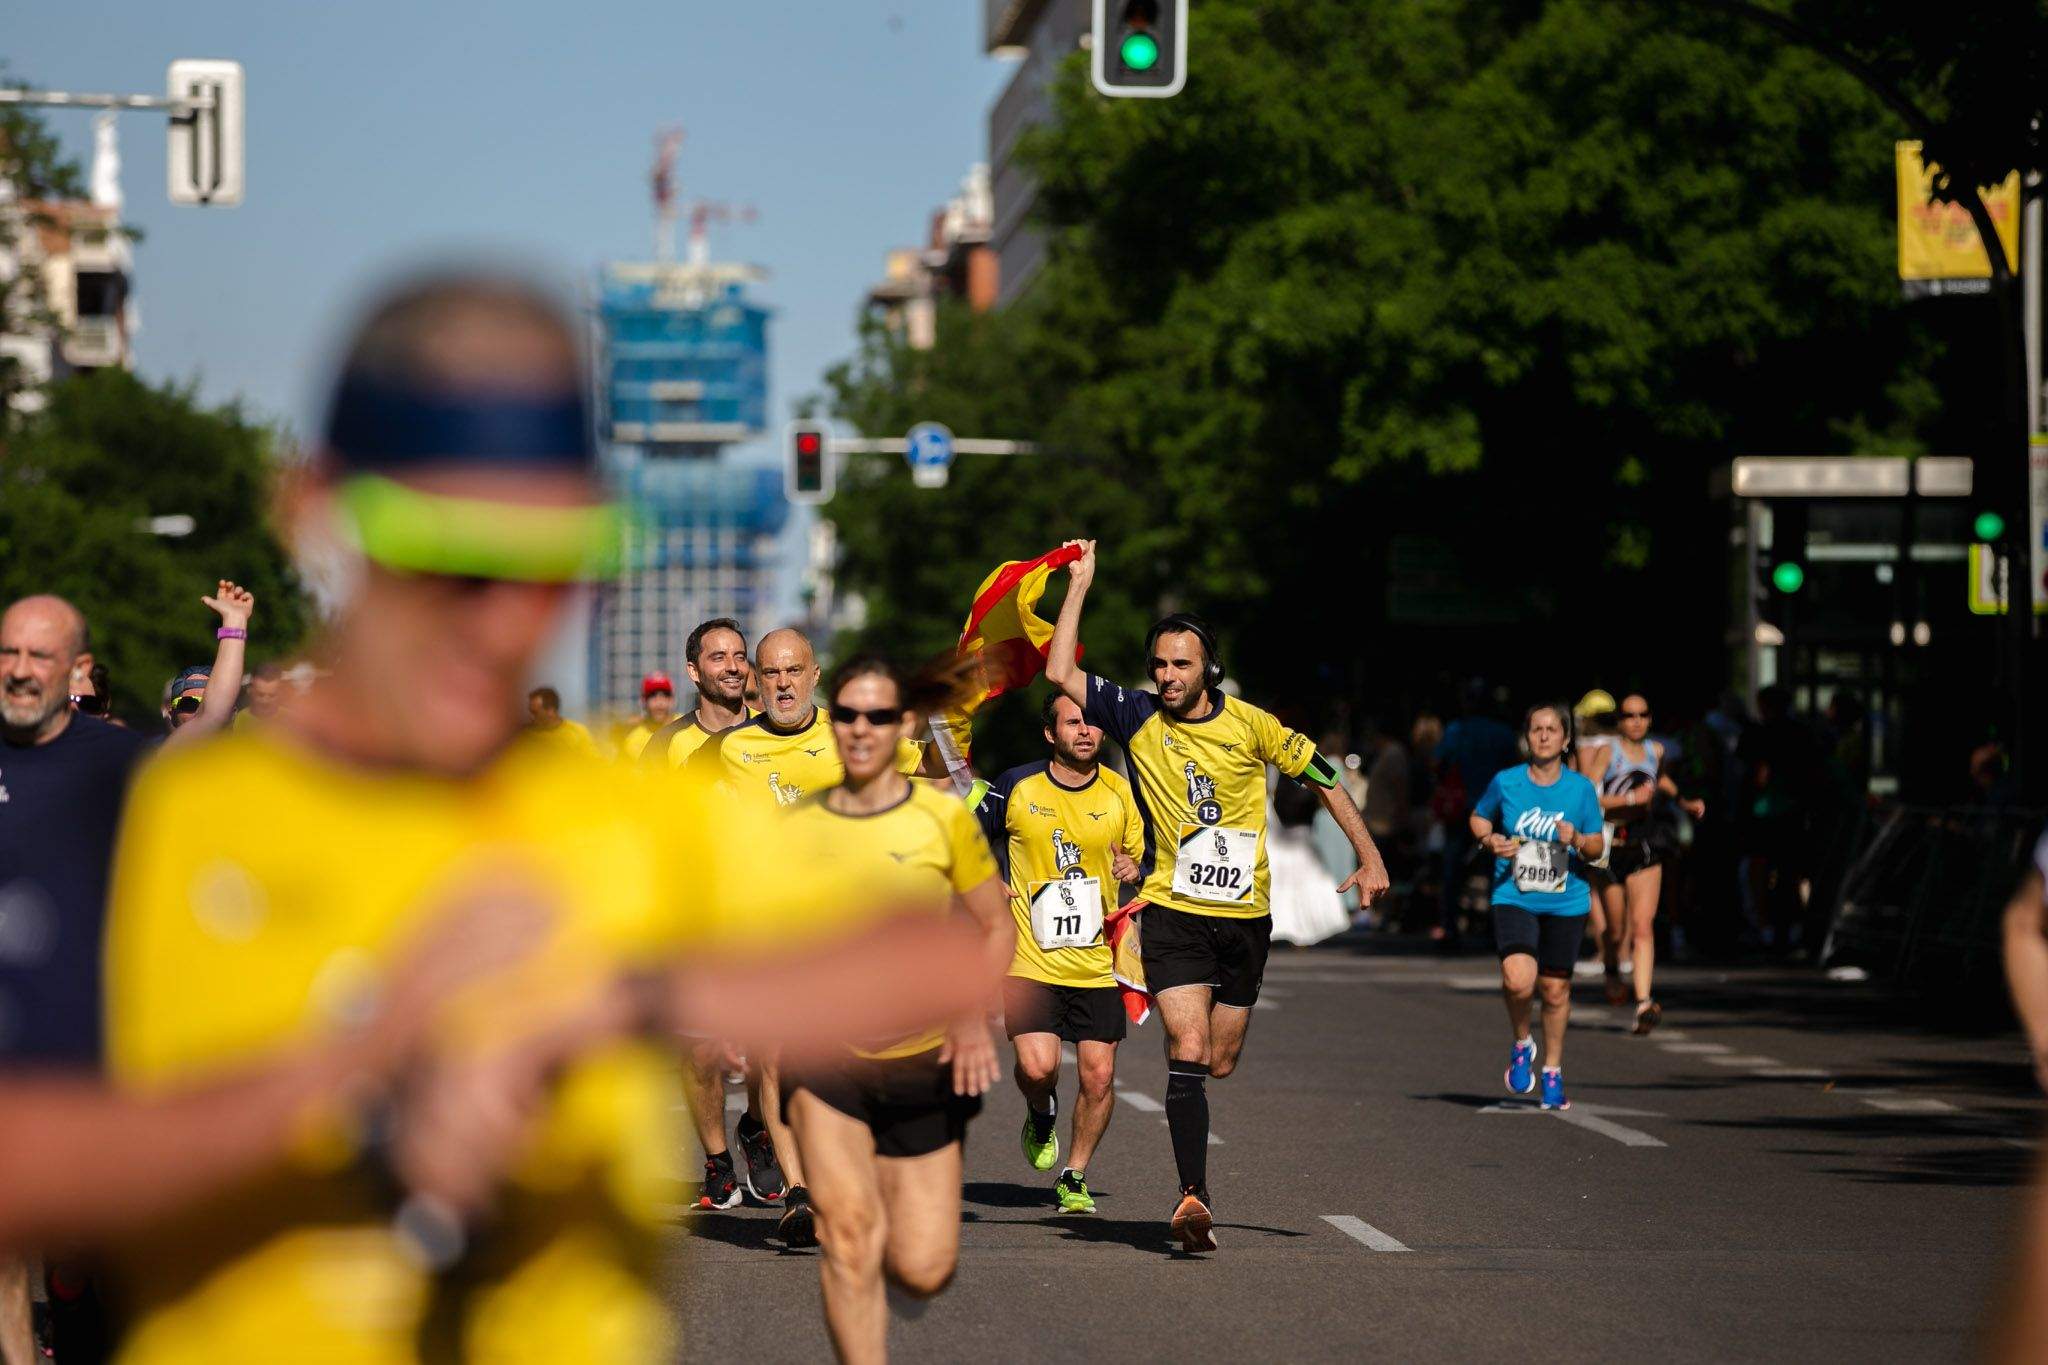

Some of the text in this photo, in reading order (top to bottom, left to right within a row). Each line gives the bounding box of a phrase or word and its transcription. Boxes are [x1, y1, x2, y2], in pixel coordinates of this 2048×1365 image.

[1202, 806, 1218, 820] 13
[1189, 862, 1241, 889] 3202
[1519, 865, 1558, 882] 2999
[1053, 914, 1082, 936] 717
